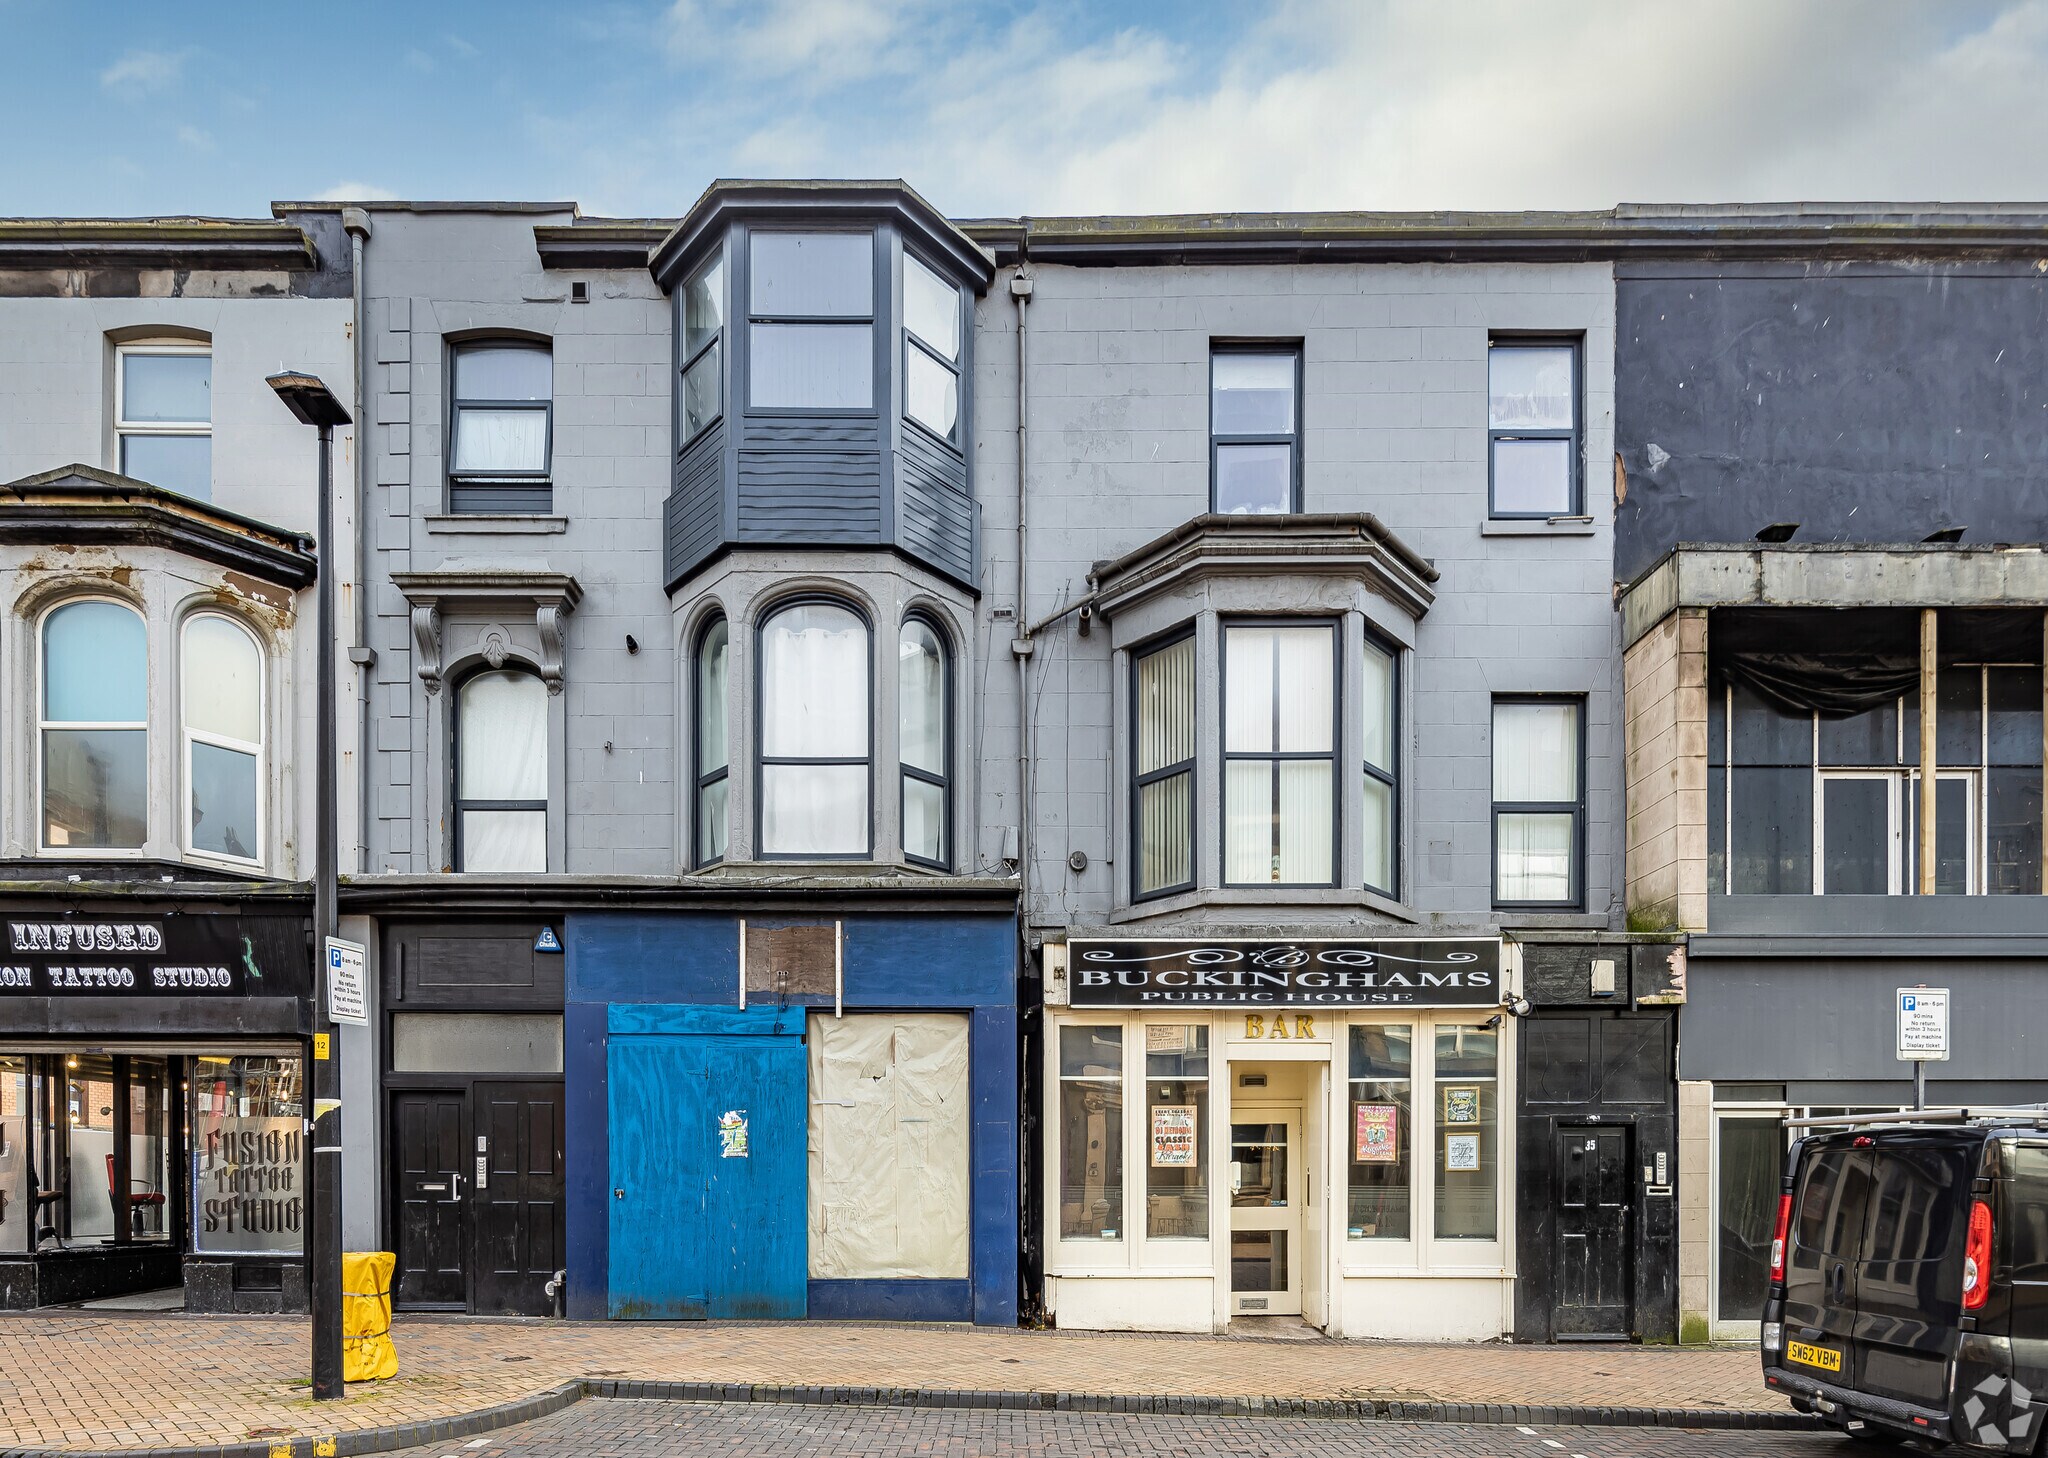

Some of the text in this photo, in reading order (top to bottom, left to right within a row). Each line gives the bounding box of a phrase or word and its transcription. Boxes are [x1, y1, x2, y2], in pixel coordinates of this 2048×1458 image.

[11, 924, 162, 950] INFUSED
[48, 966, 135, 987] TATTOO
[153, 966, 232, 987] STUDIO
[1078, 971, 1491, 987] BUCKINGHAMS
[1140, 992, 1413, 1002] PUBLIC HOUSE
[1245, 1014, 1316, 1038] BAR
[206, 1128, 300, 1170] FUSION
[1585, 1140, 1595, 1150] 35
[214, 1166, 294, 1193] TATTOO
[204, 1194, 304, 1233] STUDIO
[1817, 1350, 1836, 1367] VBM
